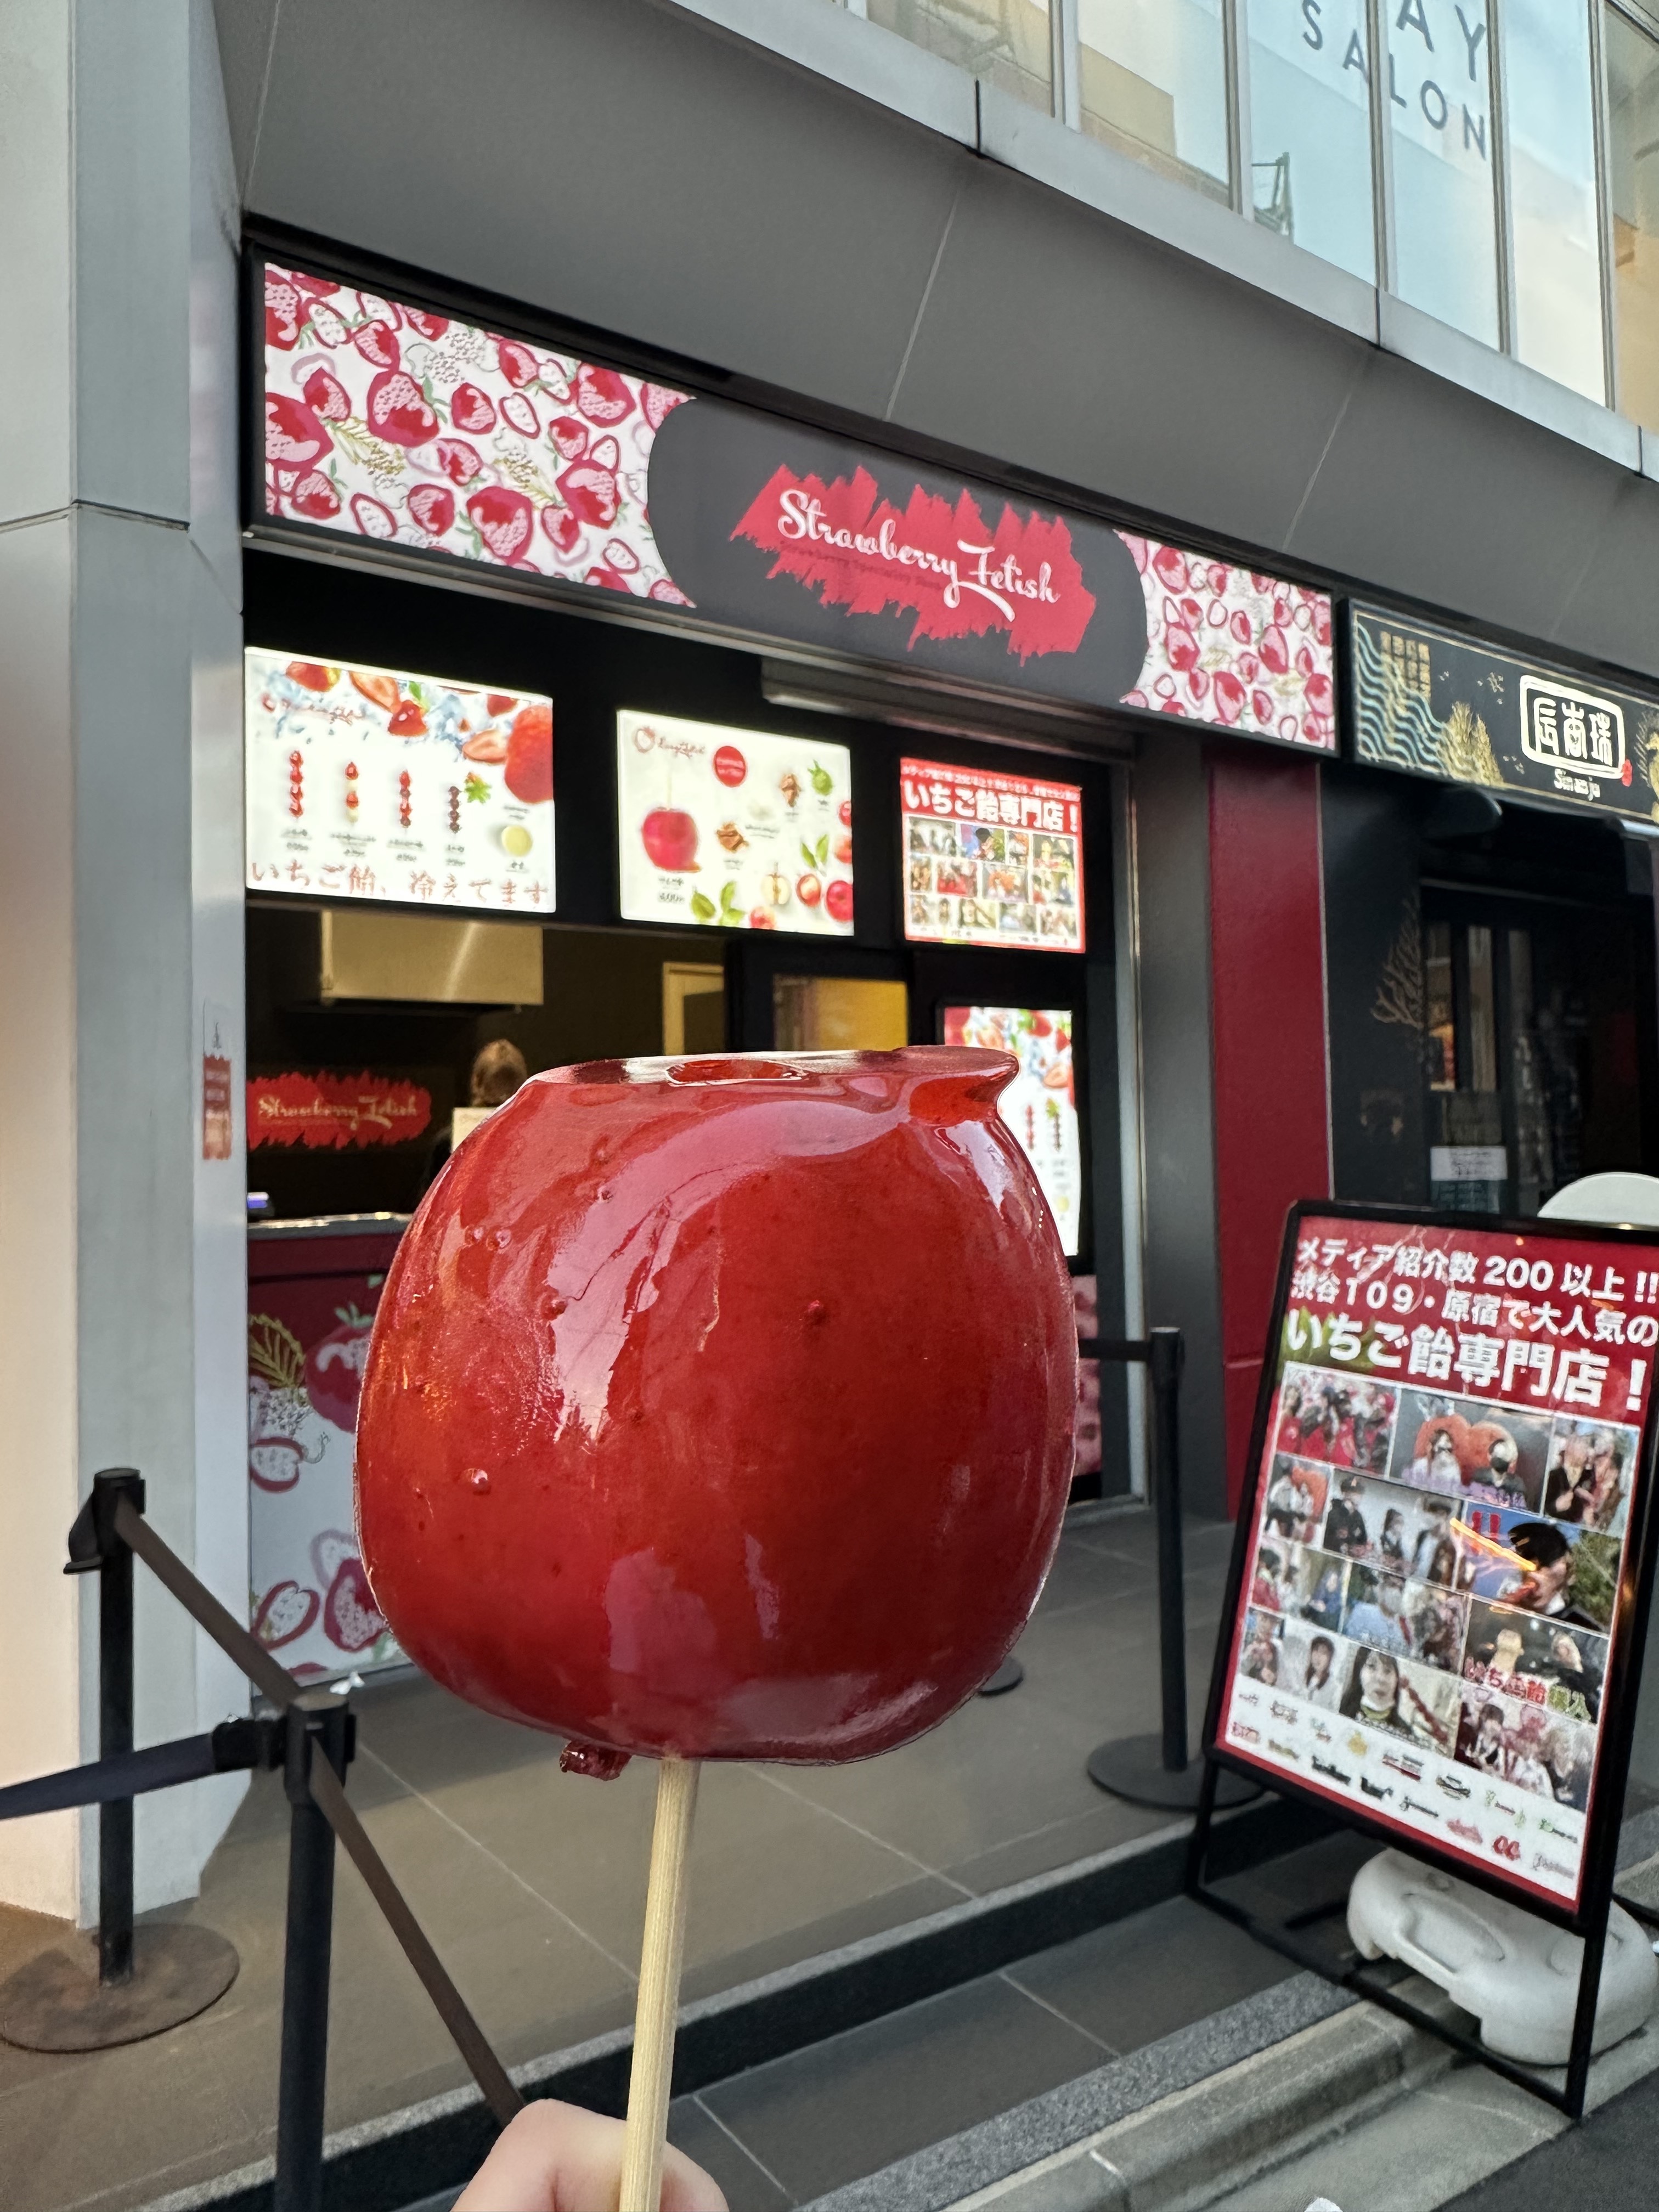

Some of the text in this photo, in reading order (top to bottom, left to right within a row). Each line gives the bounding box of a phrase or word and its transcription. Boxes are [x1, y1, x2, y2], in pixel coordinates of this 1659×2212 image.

[1302, 0, 1487, 160] SALON
[777, 489, 971, 610] Strawberry
[957, 539, 1061, 603] Fetish
[1288, 1309, 1647, 1412] いちご飴専門店！
